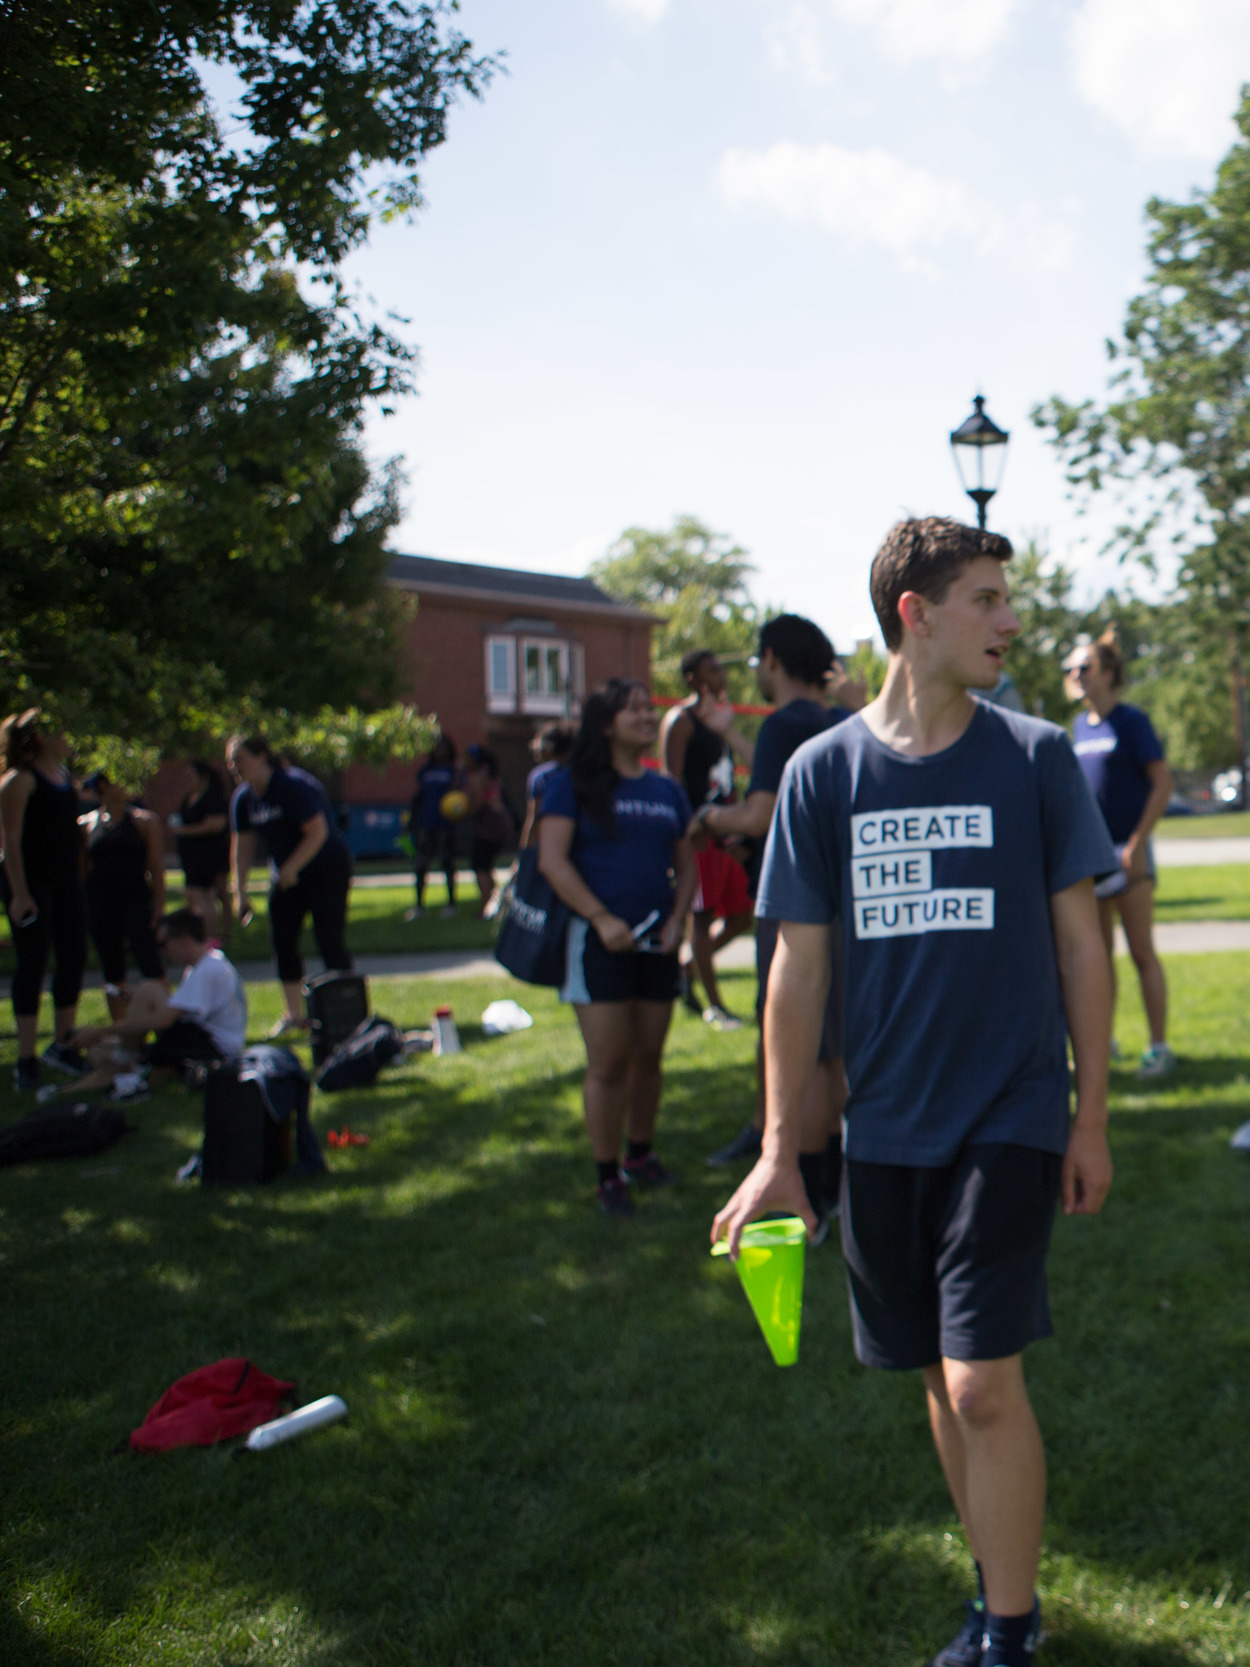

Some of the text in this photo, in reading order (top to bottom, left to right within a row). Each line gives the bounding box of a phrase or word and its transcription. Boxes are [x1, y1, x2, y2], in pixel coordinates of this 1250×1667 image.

[859, 814, 982, 846] CREATE
[859, 860, 921, 888] THE
[862, 898, 983, 930] FUTURE
